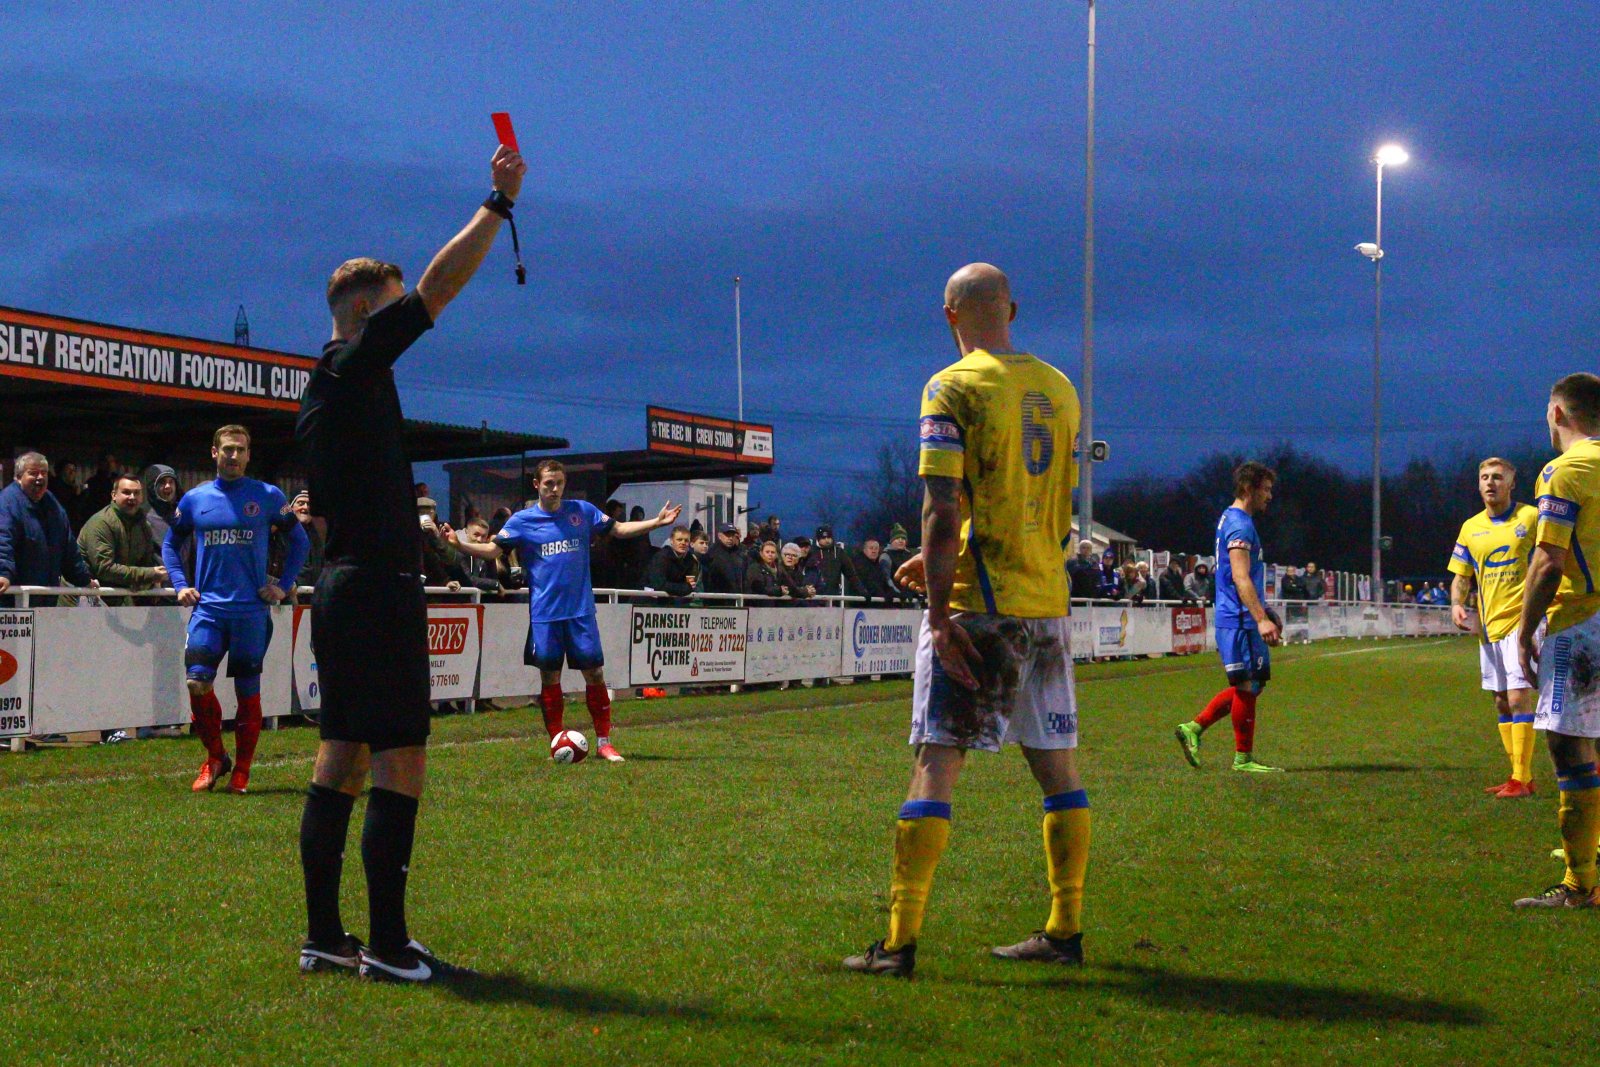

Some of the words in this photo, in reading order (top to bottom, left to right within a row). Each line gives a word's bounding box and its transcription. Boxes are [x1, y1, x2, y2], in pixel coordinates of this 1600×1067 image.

[54, 333, 175, 384] RECREATION
[181, 353, 266, 396] FOOTBALL
[657, 421, 670, 439] THE
[671, 423, 684, 442] REC
[685, 426, 692, 443] IN
[696, 427, 714, 446] CREW
[714, 430, 734, 448] STAND
[1021, 391, 1055, 477] 6
[204, 529, 236, 546] RBDS
[541, 540, 569, 557] RBDS
[633, 612, 691, 644] BARNSLEY
[700, 616, 737, 630] TELEPHONE
[644, 632, 690, 664] TOWBAR
[690, 633, 713, 652] 01226
[719, 633, 745, 652] 217222
[651, 649, 690, 681] CENTRE
[436, 673, 460, 687] 776100
[1, 715, 26, 730] 9795
